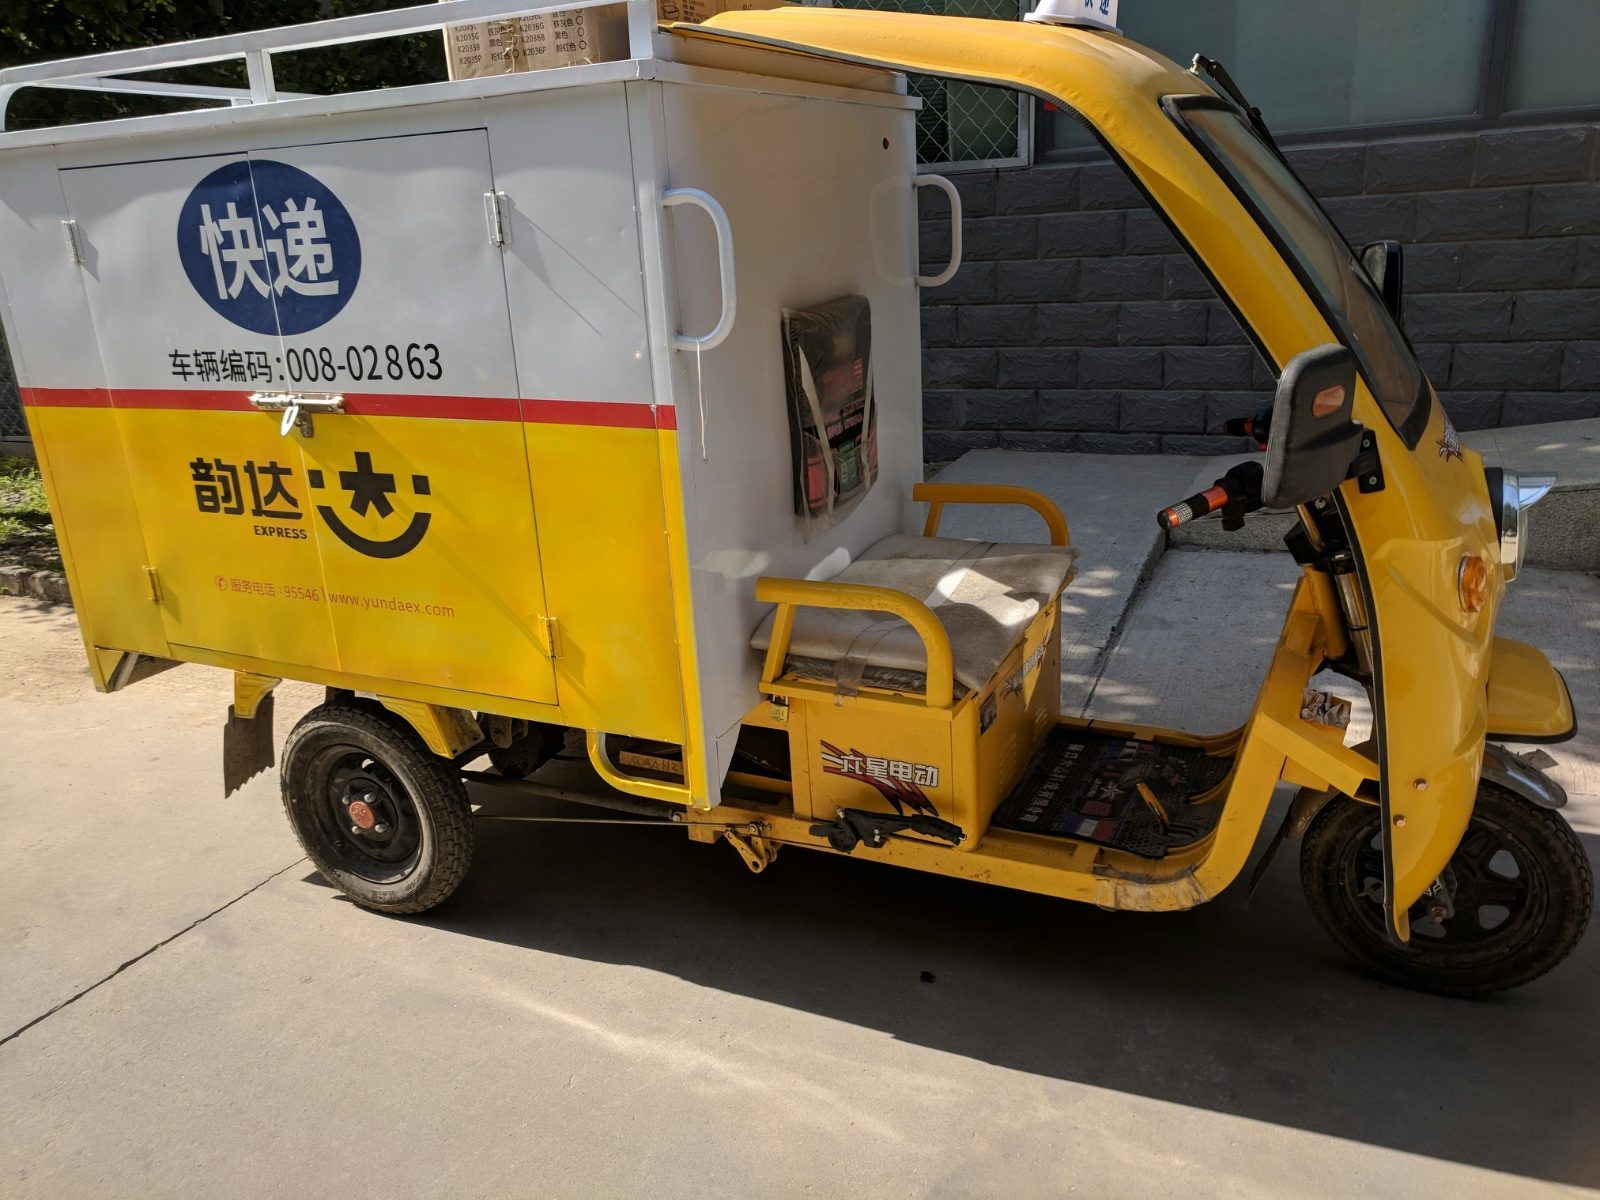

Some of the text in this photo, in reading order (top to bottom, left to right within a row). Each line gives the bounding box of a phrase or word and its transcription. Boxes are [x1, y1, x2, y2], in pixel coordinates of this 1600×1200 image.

[199, 197, 339, 300] 快递
[189, 457, 303, 520] 韵达
[253, 524, 308, 540] EXPRESS
[328, 590, 456, 618] www.yundaex.com
